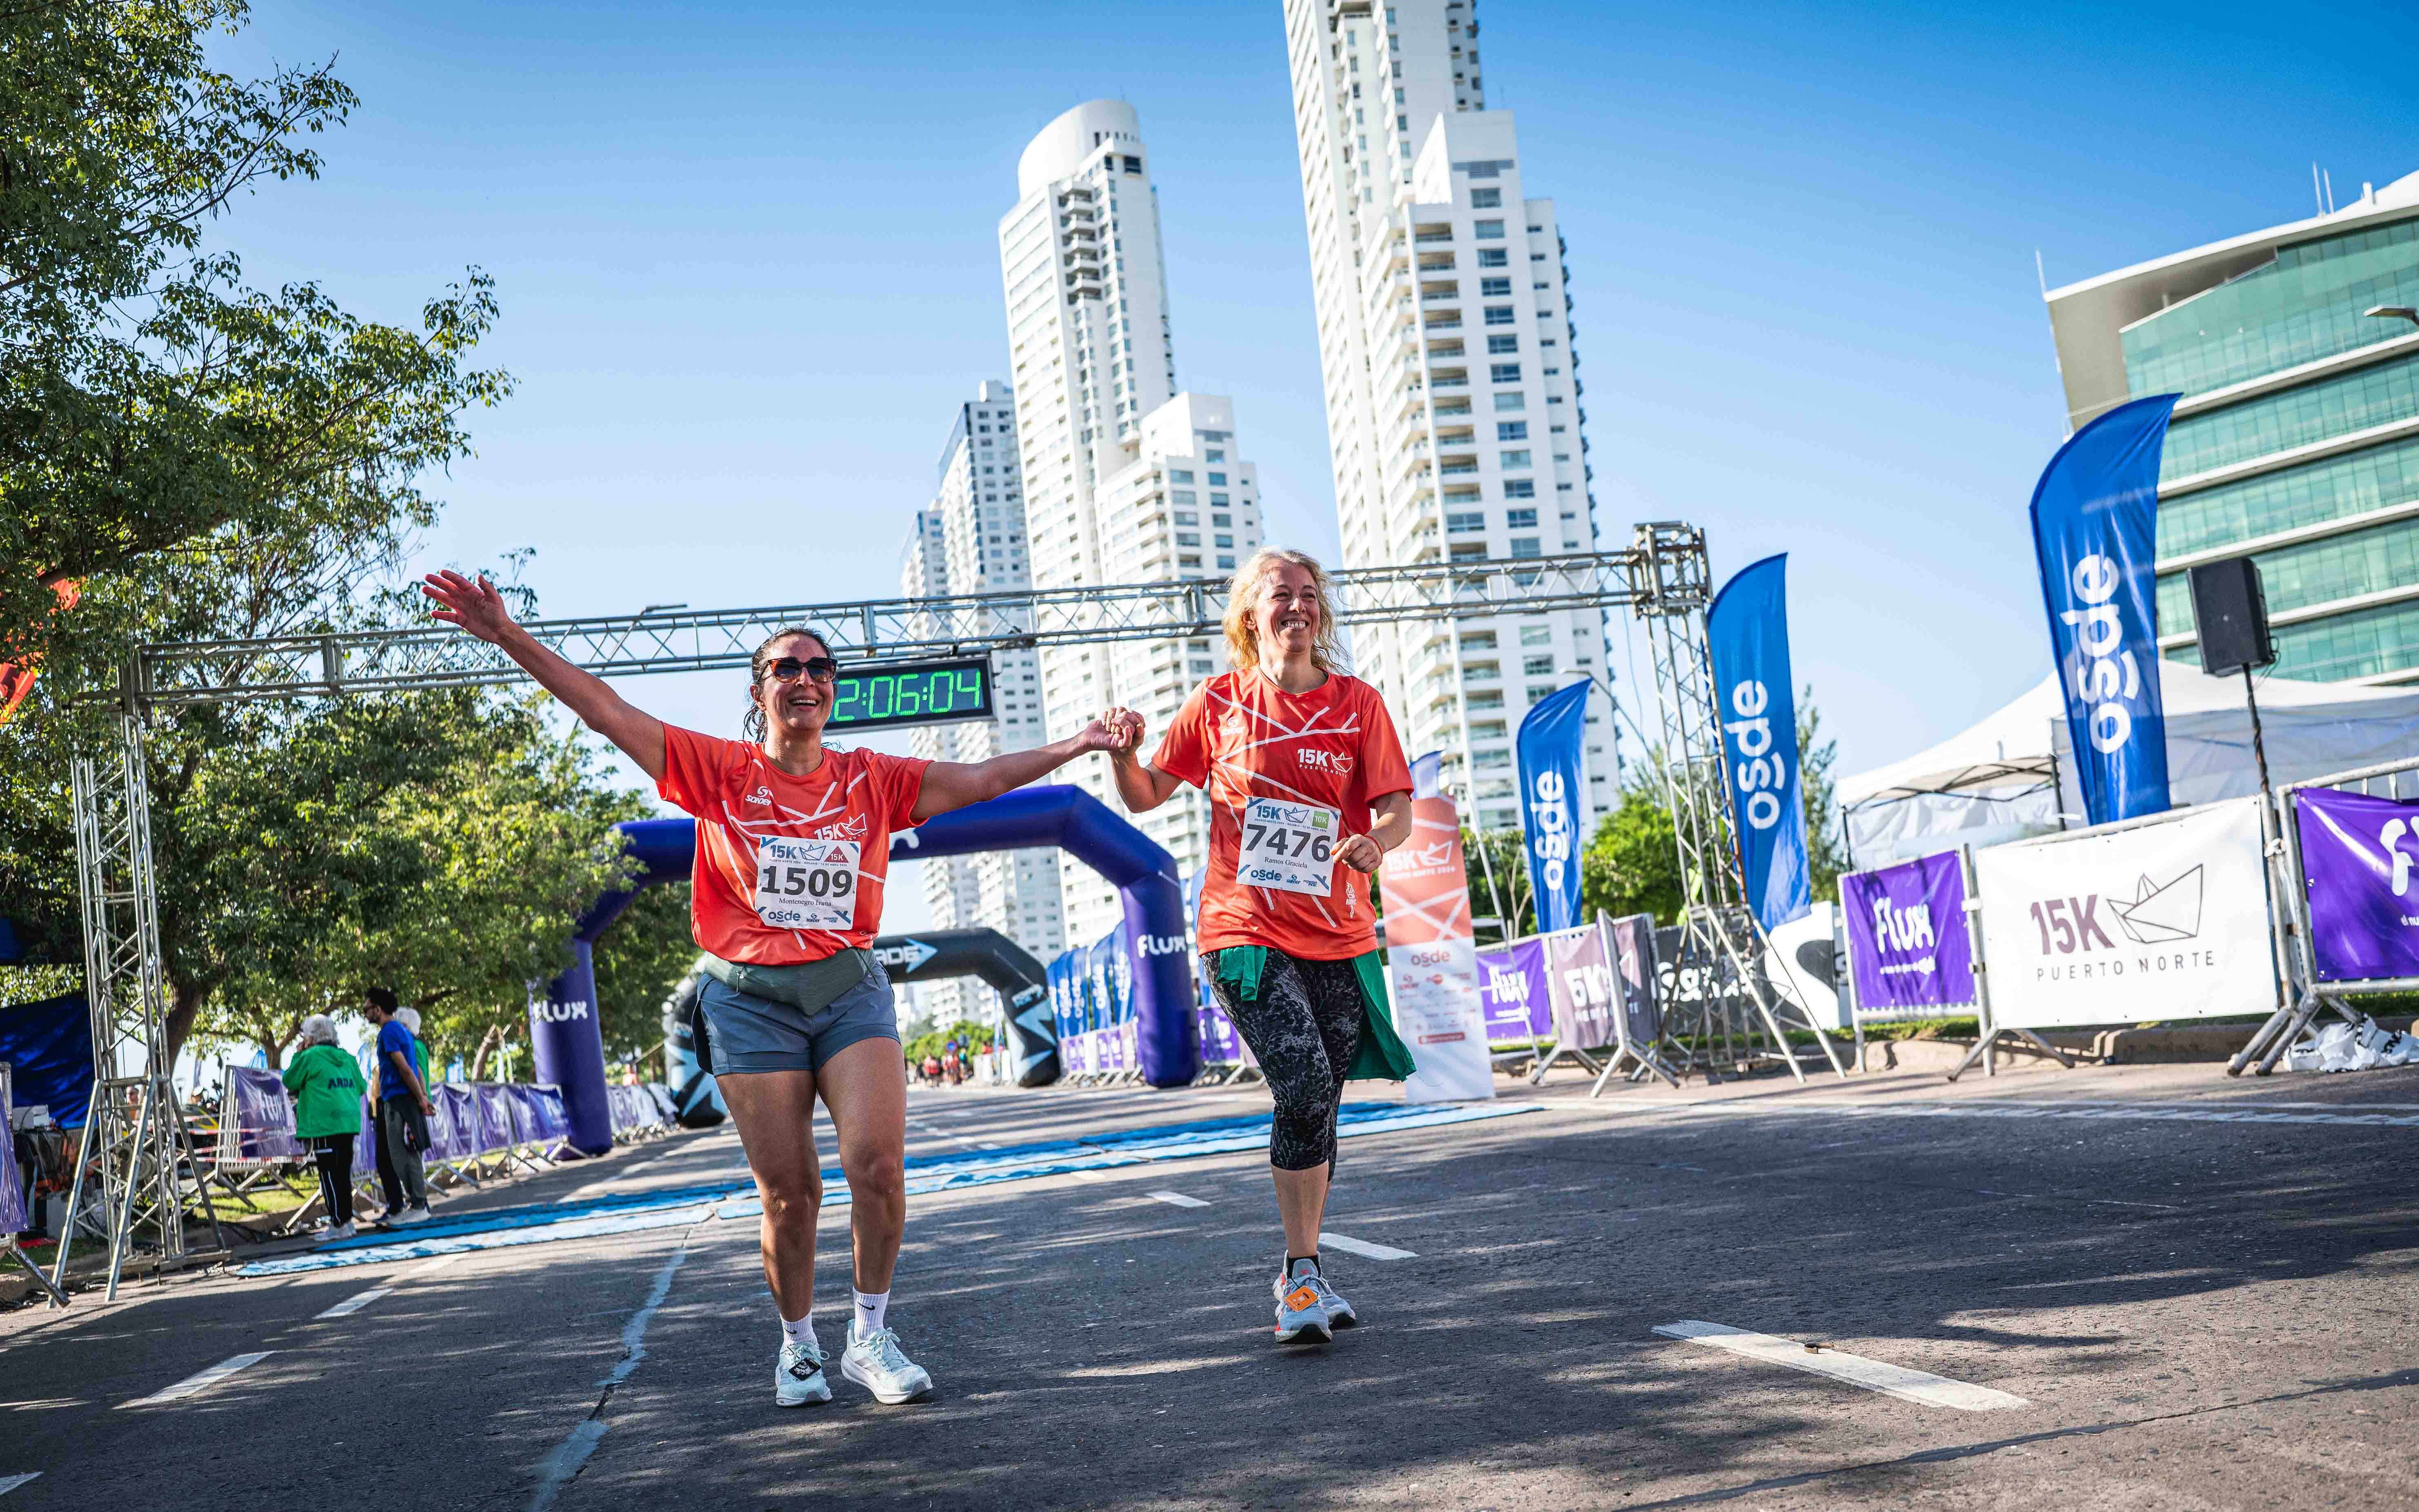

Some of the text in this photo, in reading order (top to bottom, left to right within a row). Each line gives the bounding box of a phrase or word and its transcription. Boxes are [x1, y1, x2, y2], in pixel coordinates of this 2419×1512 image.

[2060, 554, 2140, 754] osde
[1297, 748, 1329, 766] 15K
[1723, 679, 1785, 830] osde
[1299, 764, 1328, 772] PUERTO
[1256, 805, 1282, 819] 15K
[1530, 770, 1570, 890] osde
[771, 845, 797, 859] 15K
[1245, 824, 1331, 862] 7476
[1264, 857, 1307, 868] Ramos Graciela
[762, 866, 852, 898] 1509
[1251, 869, 1282, 881] osde
[768, 910, 800, 922] osde
[2030, 894, 2116, 955] 15K
[1411, 949, 1450, 967] osde
[2037, 950, 2214, 981] PUERTO NORTE
